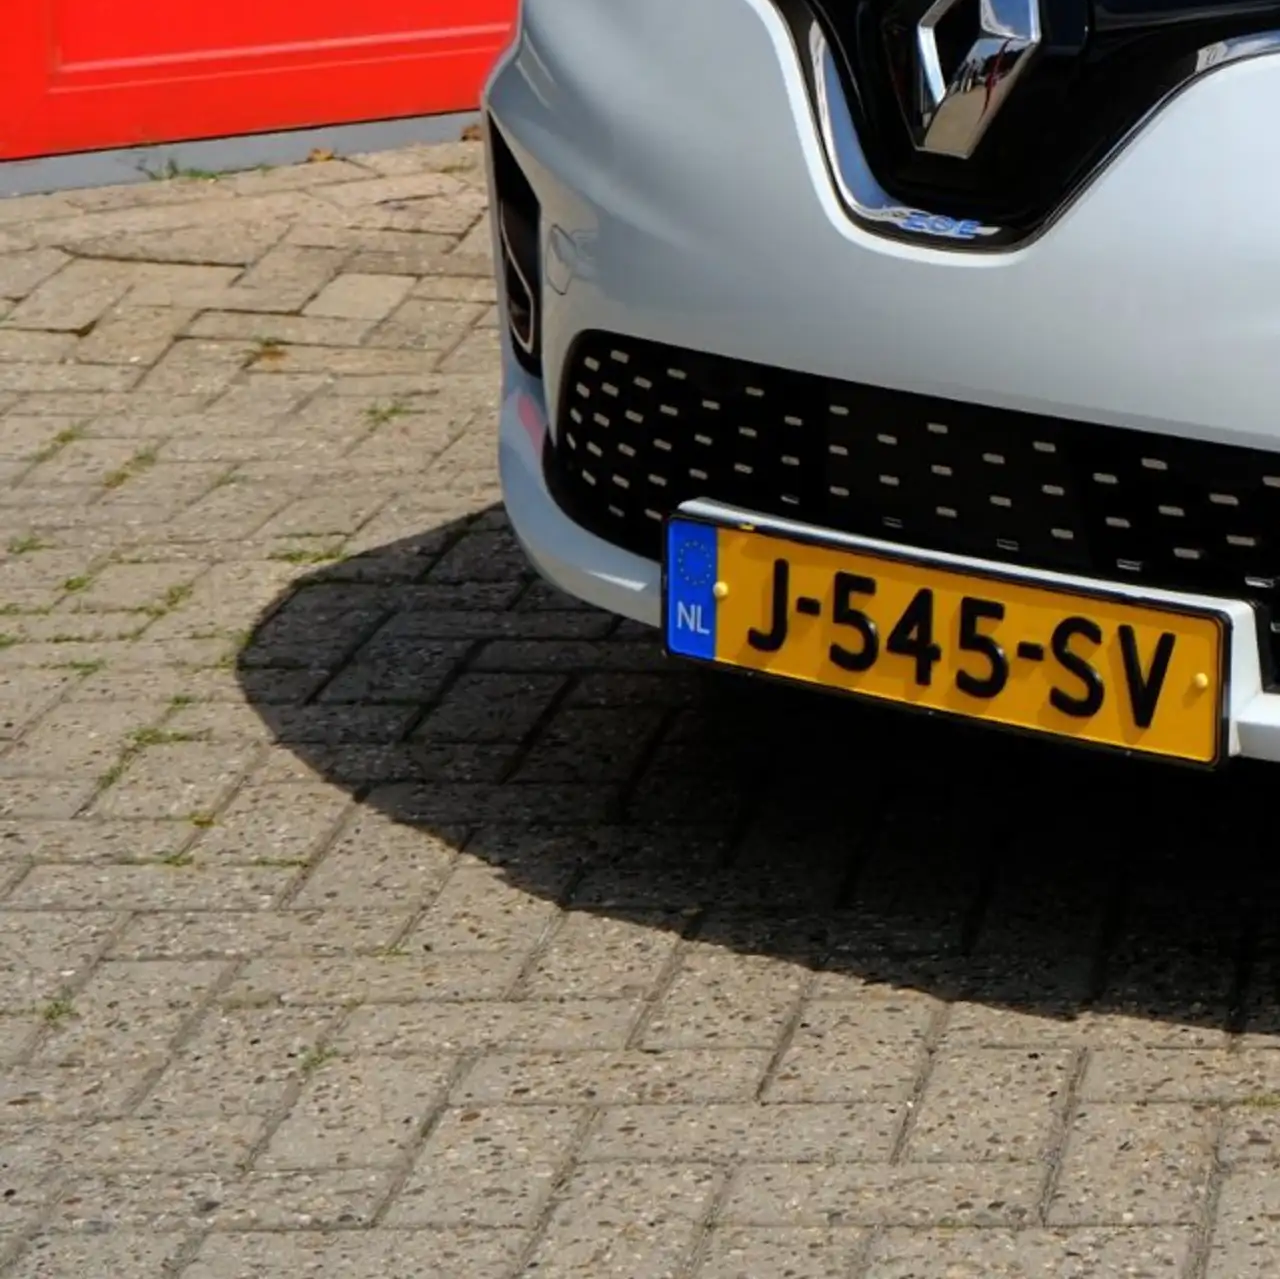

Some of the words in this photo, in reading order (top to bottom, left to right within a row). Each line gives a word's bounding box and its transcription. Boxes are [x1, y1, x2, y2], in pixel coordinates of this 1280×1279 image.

[902, 211, 982, 236] ZOE
[676, 600, 710, 635] NL
[747, 558, 1176, 729] J-545-SV
